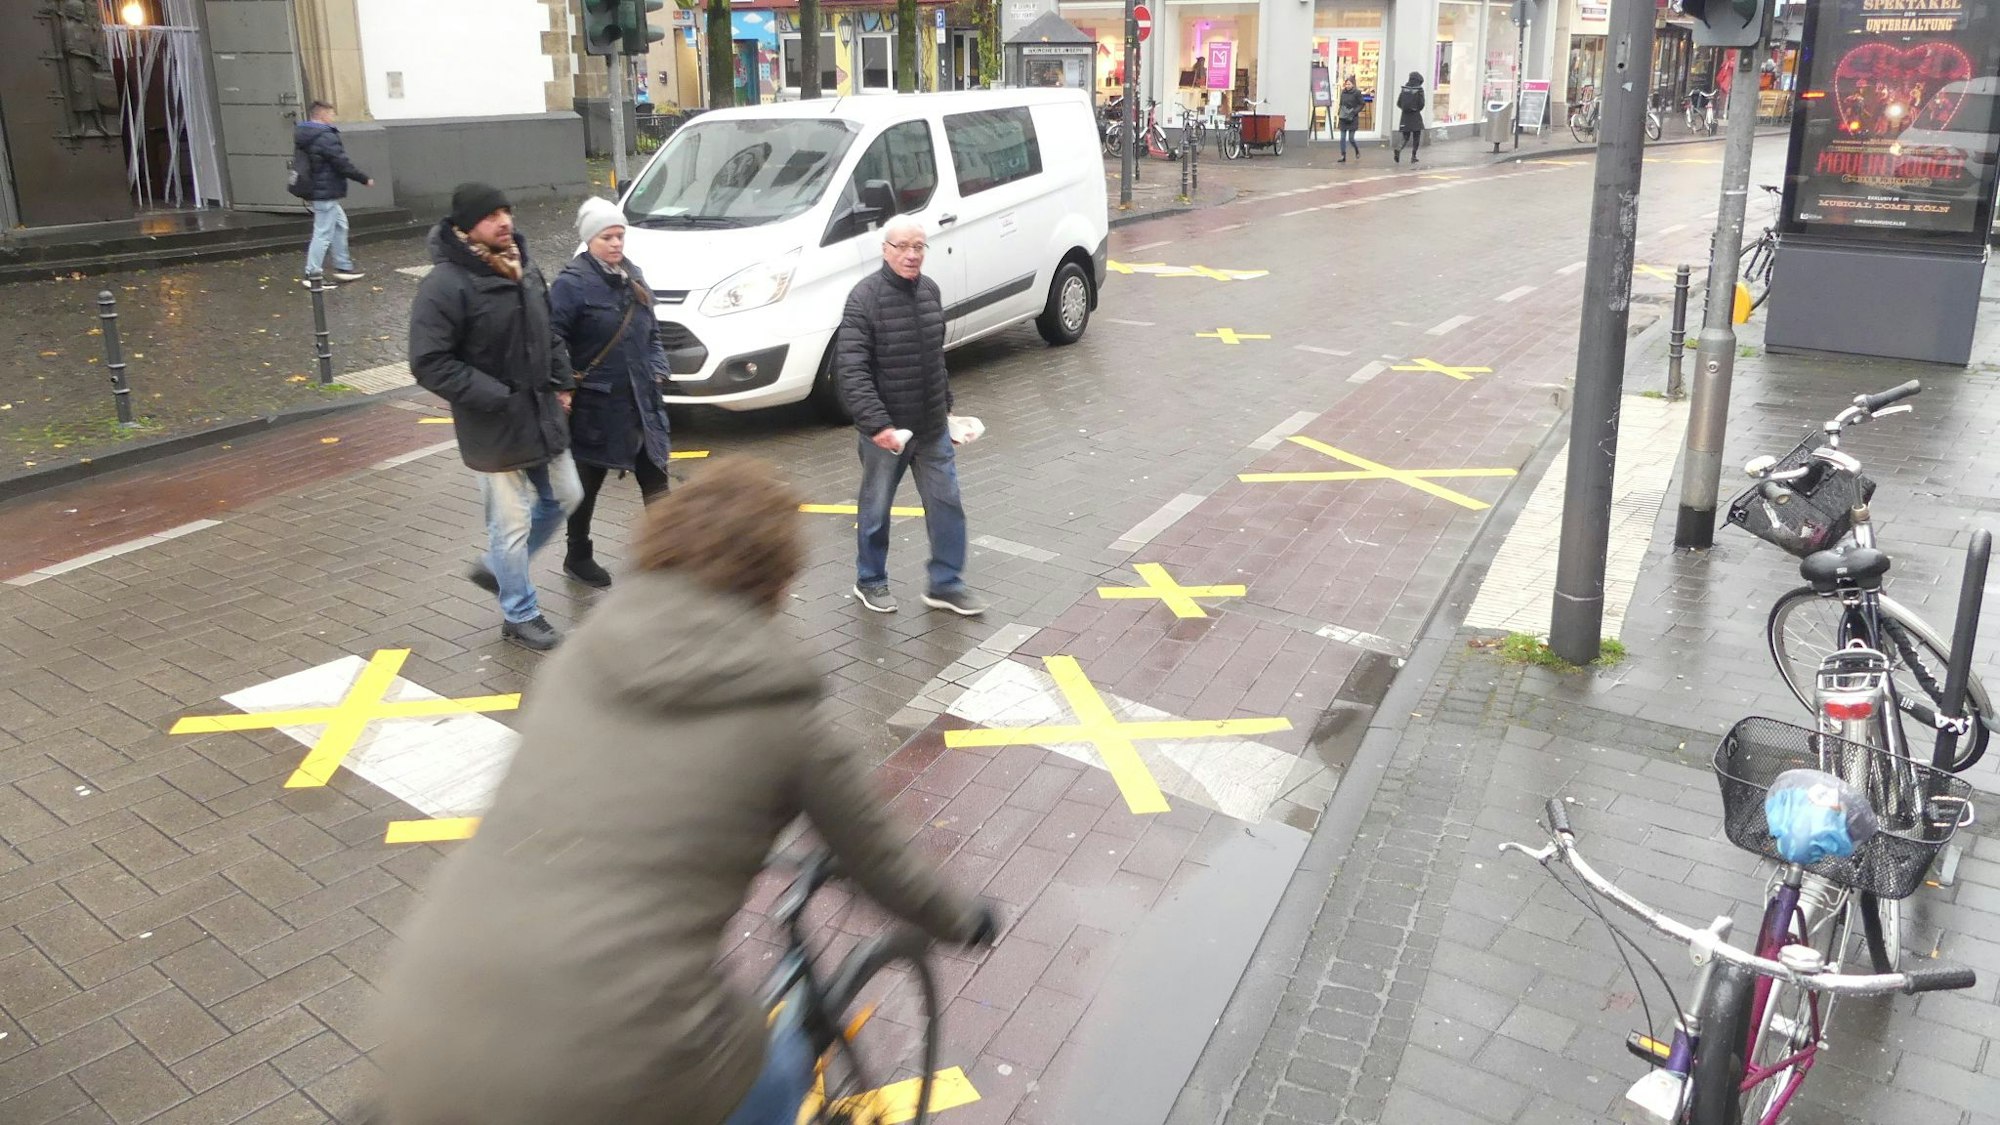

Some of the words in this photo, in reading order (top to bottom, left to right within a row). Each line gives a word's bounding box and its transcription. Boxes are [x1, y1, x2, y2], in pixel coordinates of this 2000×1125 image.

[1863, 0, 1962, 10] SPEKTAKEL
[1816, 150, 1888, 176] MOULIN
[1817, 199, 1872, 209] MUSICAL
[1874, 202, 1911, 211] DOME
[1913, 204, 1951, 213] KÖLN
